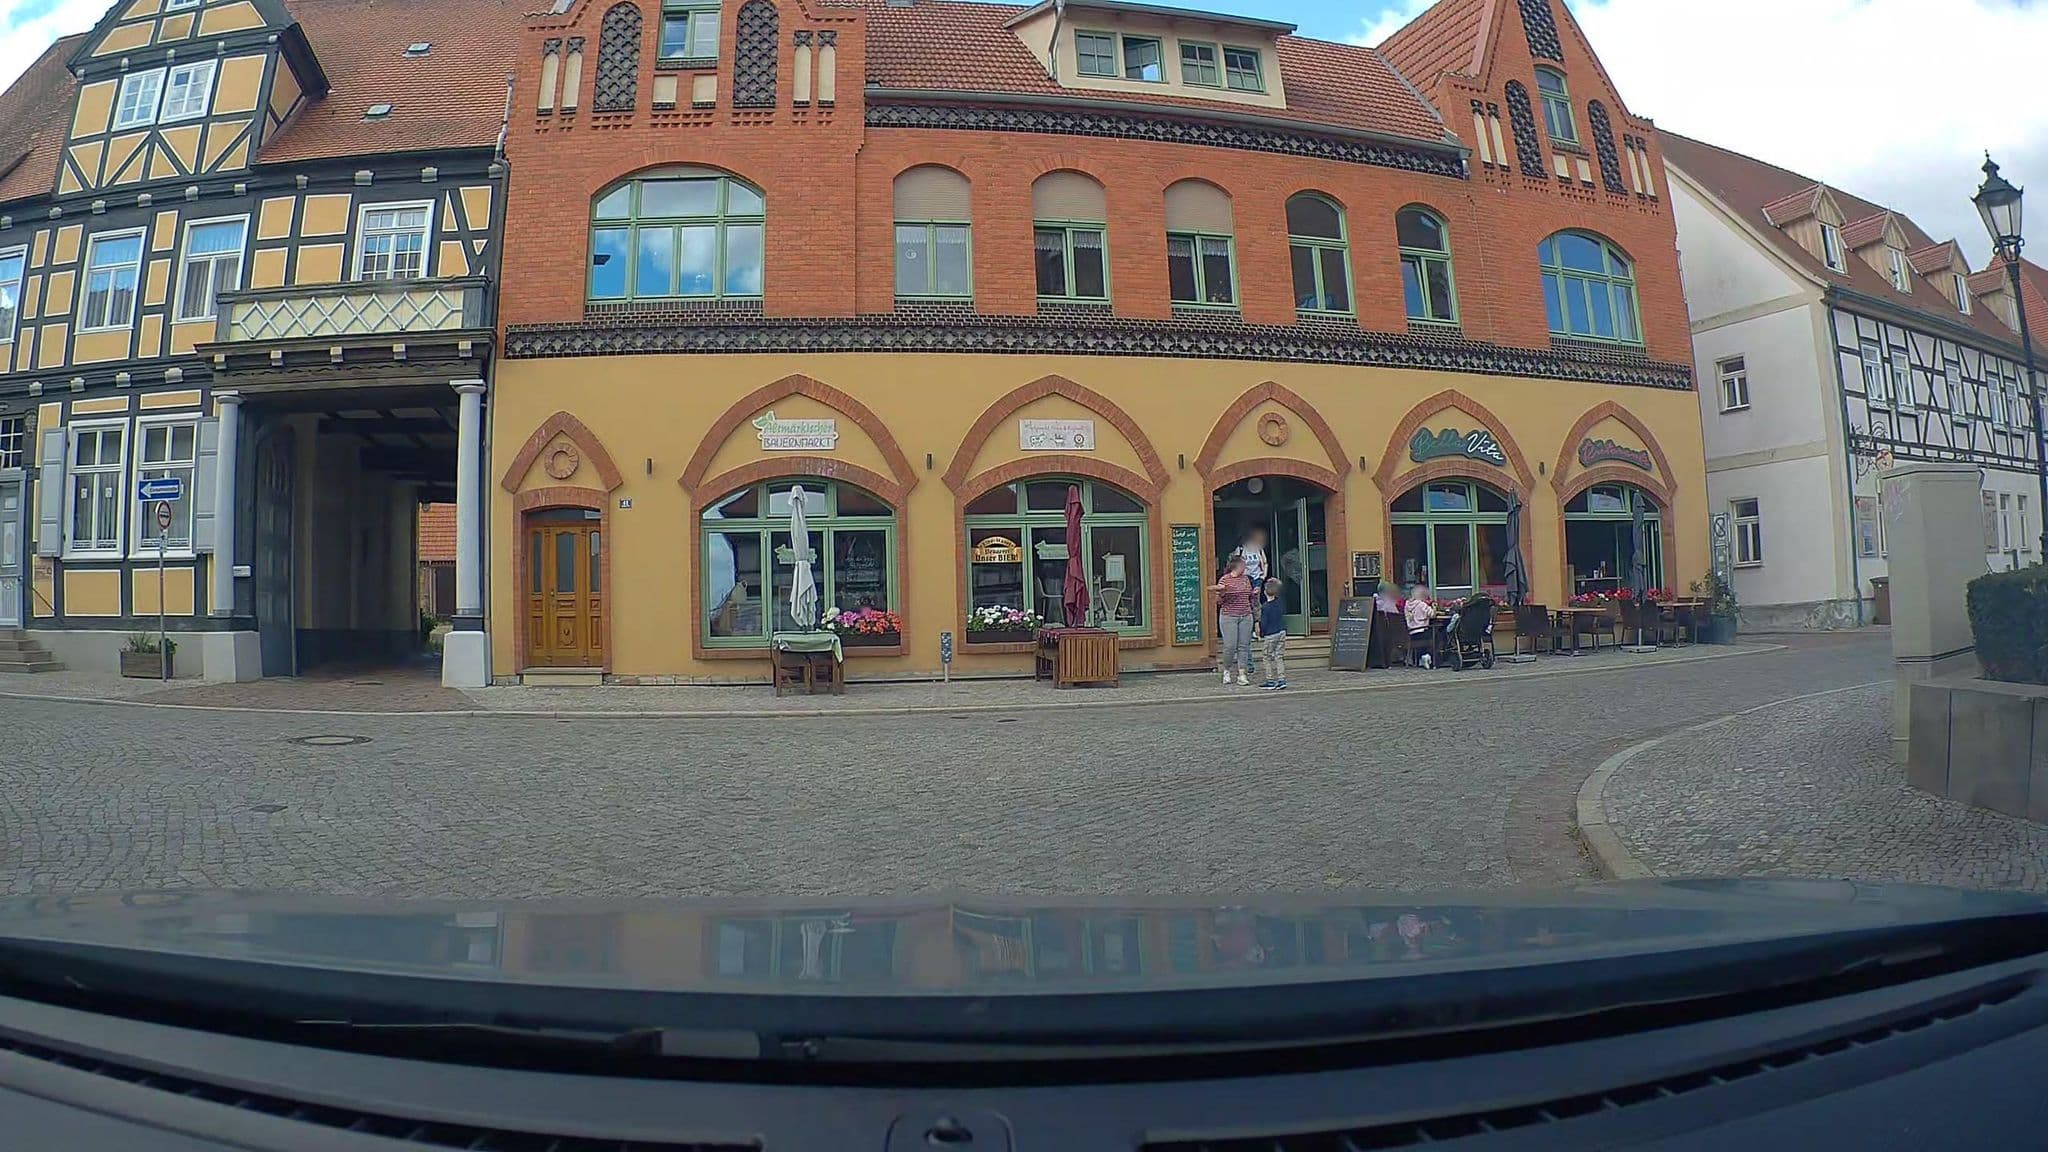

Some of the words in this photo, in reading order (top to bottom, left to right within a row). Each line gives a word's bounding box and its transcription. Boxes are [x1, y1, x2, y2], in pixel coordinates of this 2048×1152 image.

[764, 421, 832, 436] Altmärkischer
[764, 437, 832, 448] BAUERNMARKT
[1414, 429, 1465, 456] Bella
[1467, 433, 1505, 460] Vita
[975, 554, 997, 562] Unser
[998, 554, 1018, 562] BIER!
